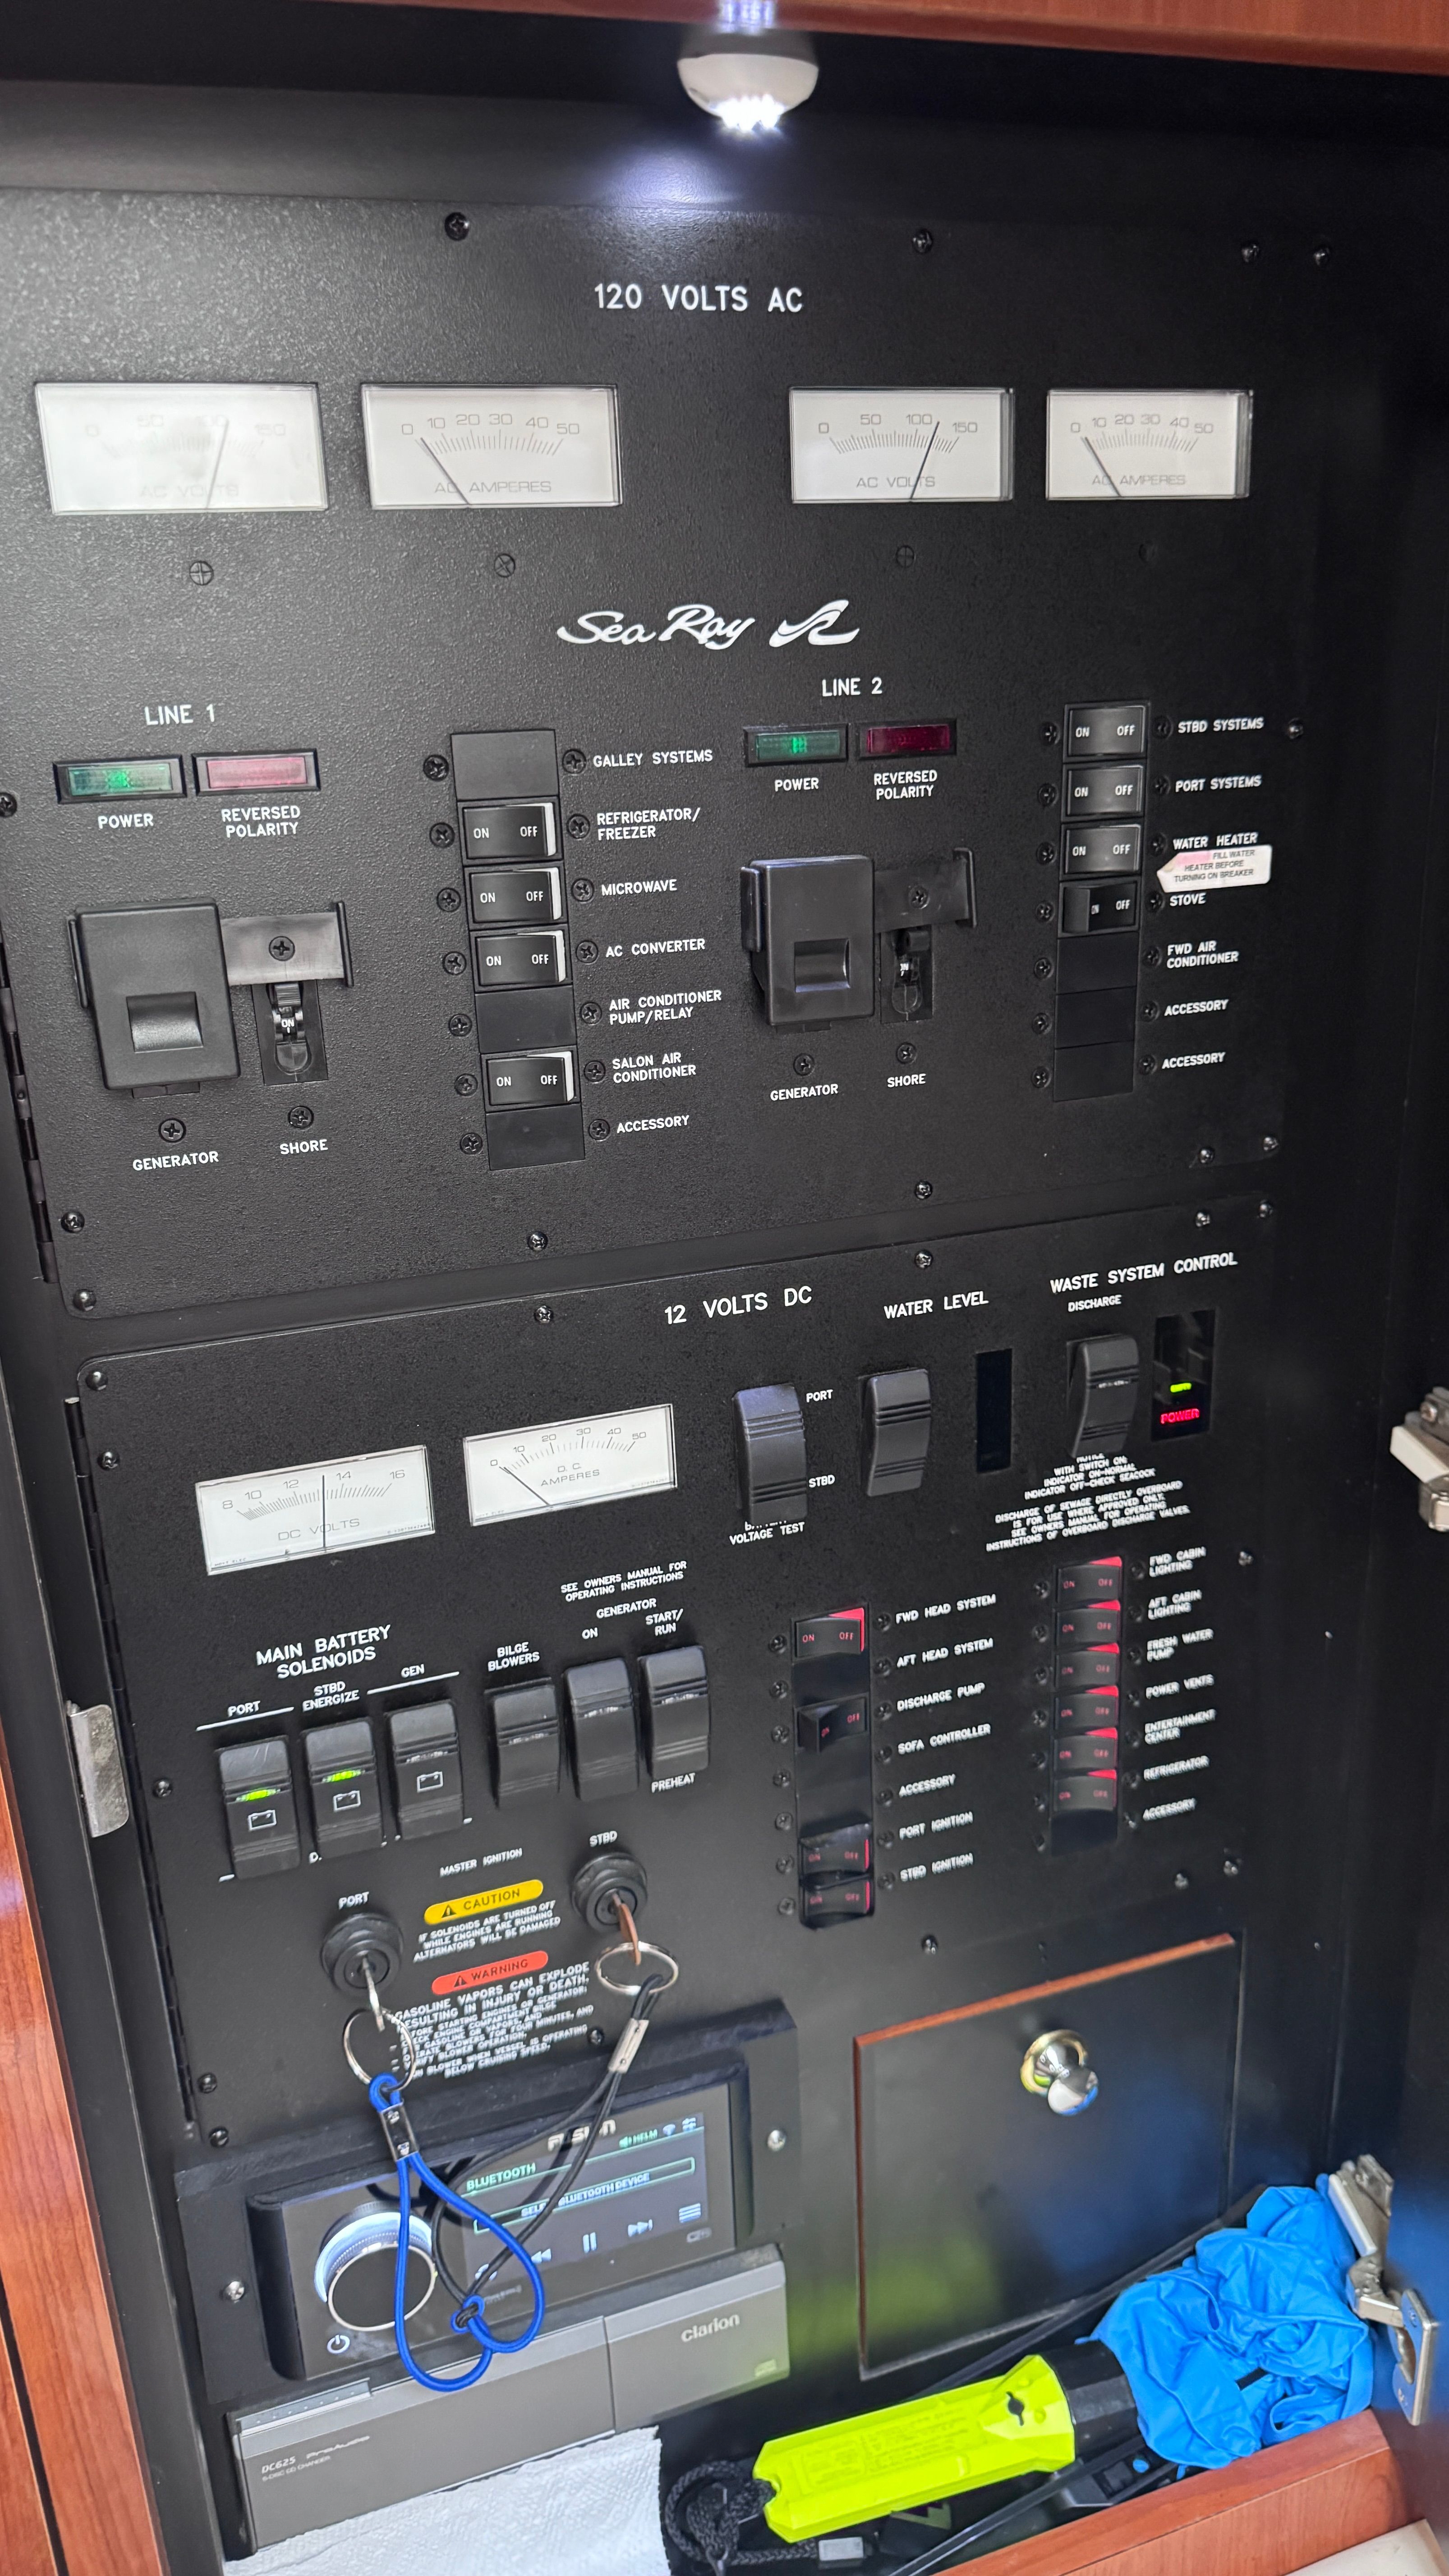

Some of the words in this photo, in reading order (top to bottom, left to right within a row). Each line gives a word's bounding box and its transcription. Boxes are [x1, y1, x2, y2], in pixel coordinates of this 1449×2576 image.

[595, 283, 642, 308] 120
[662, 285, 747, 311] VOLTS
[768, 287, 802, 312] AC
[401, 424, 413, 435] 0
[427, 418, 445, 429] 10
[456, 414, 480, 425] 20
[489, 414, 512, 425] 30
[525, 417, 548, 428] 40
[557, 423, 580, 434] 50
[819, 423, 829, 433] 0
[860, 414, 881, 425] 50
[906, 414, 932, 425] 100
[952, 422, 978, 433] 150
[469, 481, 552, 492] AMPERES
[557, 611, 656, 644] Sea
[658, 604, 755, 649] Ray
[822, 678, 860, 696] LINE
[872, 677, 882, 694] 2
[145, 704, 193, 725] LINE
[207, 704, 214, 722] 1
[1076, 727, 1090, 737] ON
[1117, 725, 1135, 736] OFF
[1178, 720, 1207, 733] STBD
[1214, 718, 1264, 731] SYSTEMS
[593, 753, 643, 767] GALLEY
[653, 750, 713, 764] SYSTEMS
[775, 777, 819, 791] POWER
[874, 770, 937, 785] REVERSED
[1176, 779, 1205, 792] PORT
[1211, 775, 1261, 789] SYSTEMS
[876, 785, 934, 800] POLARITY
[98, 813, 153, 829] POWER
[221, 805, 300, 822] REVERSED
[597, 808, 700, 825] REFRIGERATOR/
[226, 822, 298, 837] POLARITY
[474, 828, 489, 838] ON
[520, 826, 537, 837] OFF
[598, 825, 656, 840] FREEZER
[1173, 836, 1208, 849] WATER
[1217, 833, 1258, 846] HEATER
[1213, 852, 1228, 860] FILL
[1229, 850, 1255, 858] WATER
[1185, 863, 1213, 871] HEATER
[1215, 860, 1244, 869] BEFORE
[1174, 874, 1206, 882] TURNING
[1220, 869, 1254, 878] BREAKER
[602, 879, 677, 896] MICROWAVE
[480, 892, 495, 903] ON
[526, 891, 543, 901] OFF
[1170, 892, 1205, 906] STOVE
[606, 945, 622, 957] AC
[631, 938, 705, 955] CONVERTER
[1168, 943, 1192, 956] FWD
[1198, 941, 1216, 952] AIR
[1167, 951, 1238, 968] CONDITIONER
[609, 998, 630, 1011] AIR
[638, 990, 722, 1007] CONDITIONER
[1164, 999, 1228, 1016] ACCESSORY
[610, 1007, 693, 1025] PUMP/RELAY
[612, 1055, 653, 1069] SALON
[662, 1052, 681, 1064] AIR
[1162, 1052, 1225, 1069] ACCESSORY
[613, 1065, 696, 1083] CONDITIONER
[888, 1074, 926, 1087] SHORE
[770, 1084, 838, 1101] GENERATOR
[617, 1115, 689, 1133] ACCESSORY
[280, 1139, 328, 1154] SHORE
[133, 1151, 219, 1170] GENERATOR
[1050, 1273, 1098, 1293] WASTE
[1108, 1263, 1164, 1284] SYSTEM
[1174, 1252, 1237, 1273] CONTROL
[665, 1305, 686, 1324] 12
[703, 1293, 768, 1318] VOLTS
[784, 1286, 811, 1306] DC
[884, 1299, 933, 1319] WATER
[944, 1291, 989, 1310] LEVEL
[1068, 1295, 1122, 1312] DISCHARGE
[806, 1389, 833, 1402] PORT
[1160, 1408, 1200, 1424] POWER
[1054, 1465, 1074, 1476] WITH
[1079, 1459, 1109, 1472] SWITCH
[1113, 1456, 1127, 1465] ON:
[541, 1469, 599, 1486] AMPERES
[809, 1475, 835, 1487] STBD
[1044, 1472, 1084, 1487] INDICATOR
[1089, 1463, 1136, 1478] ON-NORMAL
[222, 1500, 233, 1509] 8
[245, 1490, 262, 1500] 10
[283, 1480, 299, 1489] 12
[336, 1472, 351, 1480] 14
[390, 1470, 405, 1479] 16
[278, 1530, 300, 1541] DC
[309, 1519, 359, 1534] VOLTS
[729, 1528, 773, 1545] VOLTAGE
[780, 1522, 805, 1535] TEST
[1150, 1554, 1172, 1566] FWD
[1177, 1547, 1205, 1561] CABIN
[561, 1582, 578, 1593] SEE
[584, 1574, 621, 1588] OWNERS
[628, 1566, 663, 1580] MANUAL
[669, 1561, 686, 1572] FOR
[1150, 1560, 1192, 1577] LIGHTING
[566, 1585, 615, 1601] OPERATING
[621, 1571, 683, 1591] INSTRUCTIONS
[597, 1598, 656, 1618] GENERATOR
[896, 1610, 919, 1624] FWD
[925, 1604, 951, 1618] HEAD
[957, 1594, 996, 1610] SYSTEM
[646, 1609, 683, 1625] START/
[582, 1628, 598, 1639] ON
[655, 1623, 676, 1636] RUN
[257, 1643, 302, 1665] MAIN
[315, 1624, 390, 1653] BATTERY
[497, 1642, 529, 1657] BILGE
[897, 1654, 916, 1667] AFT
[922, 1648, 948, 1662] HEAD
[954, 1638, 993, 1655] SYSTEM
[277, 1647, 376, 1678] SOLENOIDS
[488, 1652, 539, 1671] BLOWERS
[401, 1664, 424, 1677] GEN
[314, 1681, 345, 1696] STBD
[897, 1690, 952, 1711] DISCHARGE
[957, 1683, 984, 1697] PUMP
[228, 1701, 260, 1716] PORT
[303, 1690, 359, 1711] ENERGIZE
[898, 1739, 924, 1754] SOFA
[930, 1724, 990, 1747] CONTROLLER
[652, 1773, 695, 1792] PREHEAT
[899, 1774, 955, 1796] ACCESSORY
[590, 1831, 617, 1846] STBD
[440, 1859, 477, 1876] MASTER
[483, 1848, 522, 1865] IGNITION
[339, 1891, 369, 1909] PORT
[464, 1889, 519, 1909] CAUTION
[430, 1920, 481, 1937] SOLENOIDS
[483, 1914, 500, 1926] ARE
[503, 1905, 537, 1920] TURNED
[539, 1900, 555, 1911] OFF
[471, 1959, 528, 1981] WARNING
[458, 1985, 503, 2006] VAPORS
[510, 1977, 533, 1992] CAN
[539, 1962, 589, 1982] EXPLODE
[466, 2162, 536, 2192] BLUETOOTH
[681, 2314, 740, 2342] clarion
[262, 2456, 296, 2474] DC625
